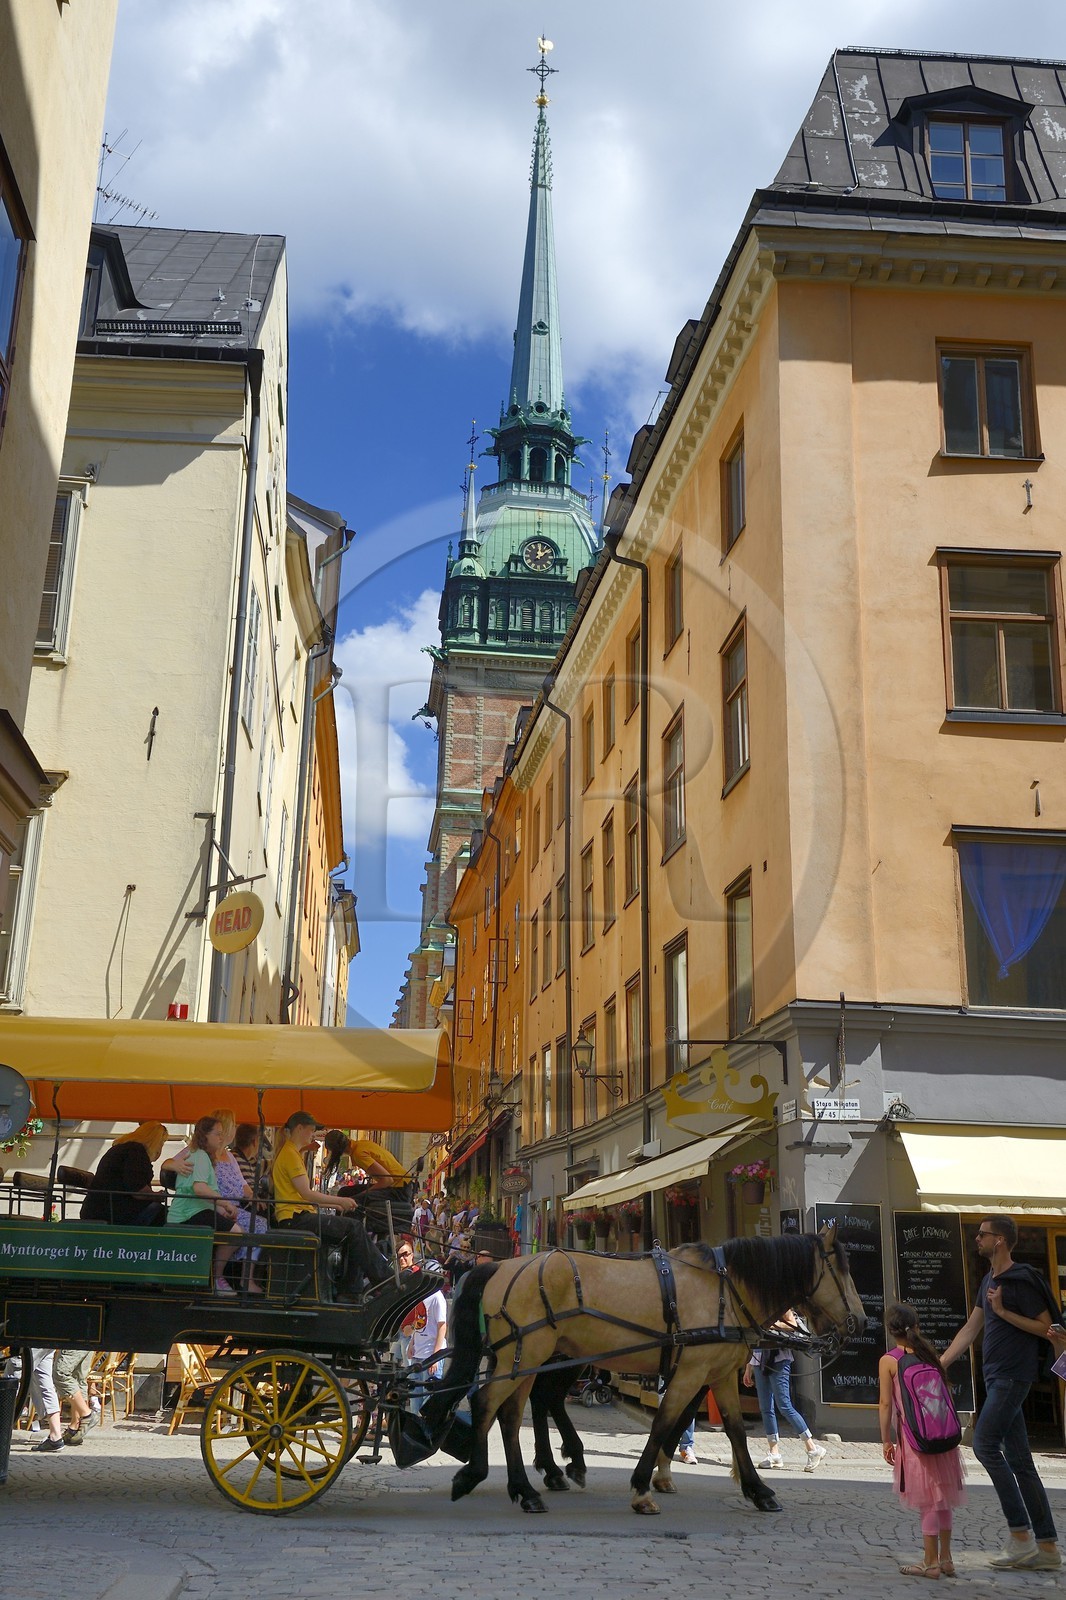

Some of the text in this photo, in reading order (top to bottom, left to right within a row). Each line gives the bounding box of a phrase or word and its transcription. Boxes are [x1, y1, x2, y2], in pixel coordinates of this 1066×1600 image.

[214, 906, 253, 937] HEAD
[708, 1099, 735, 1114] Café
[0, 1243, 198, 1263] Mynttorget by the Royal Palace
